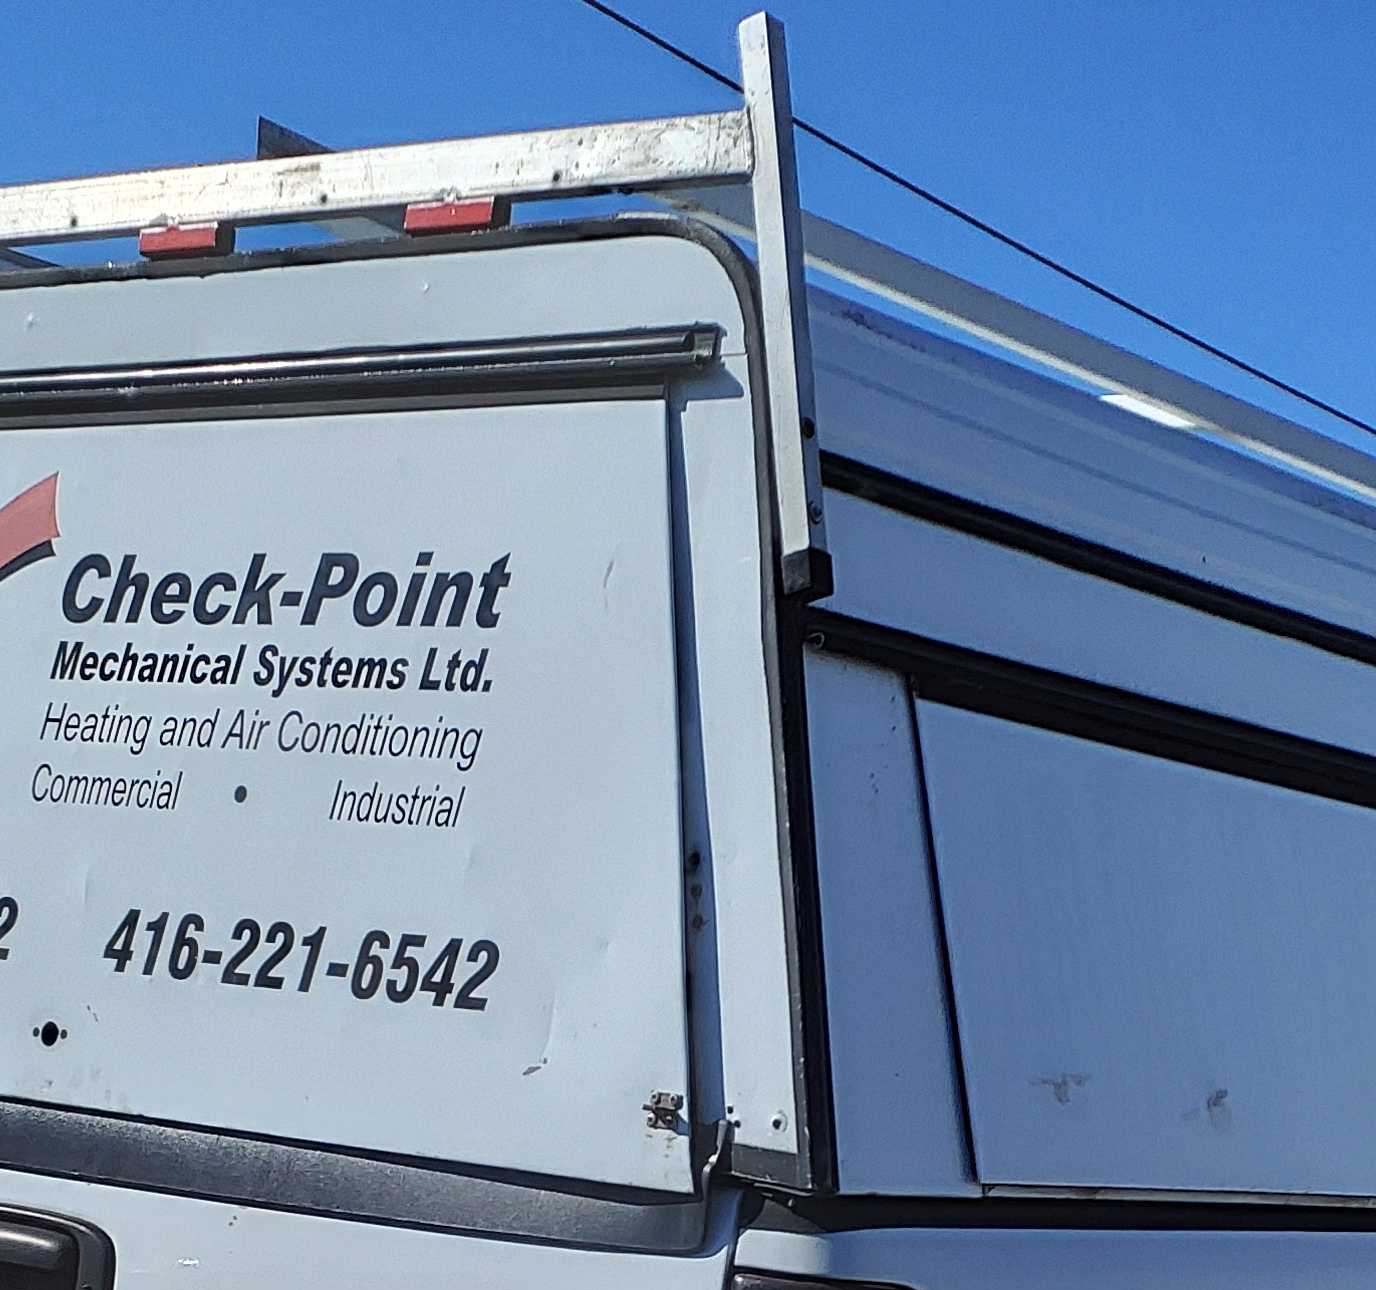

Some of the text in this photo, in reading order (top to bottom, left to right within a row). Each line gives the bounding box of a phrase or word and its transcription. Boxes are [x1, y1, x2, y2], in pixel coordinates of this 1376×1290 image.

[61, 551, 512, 629] Check-Point
[49, 640, 494, 698] Mechanical Systems Ltd.
[39, 702, 483, 772] Heating and Air Conditioning
[31, 763, 466, 828] Commercial Industrial
[103, 908, 501, 1012] 416-221-6542
